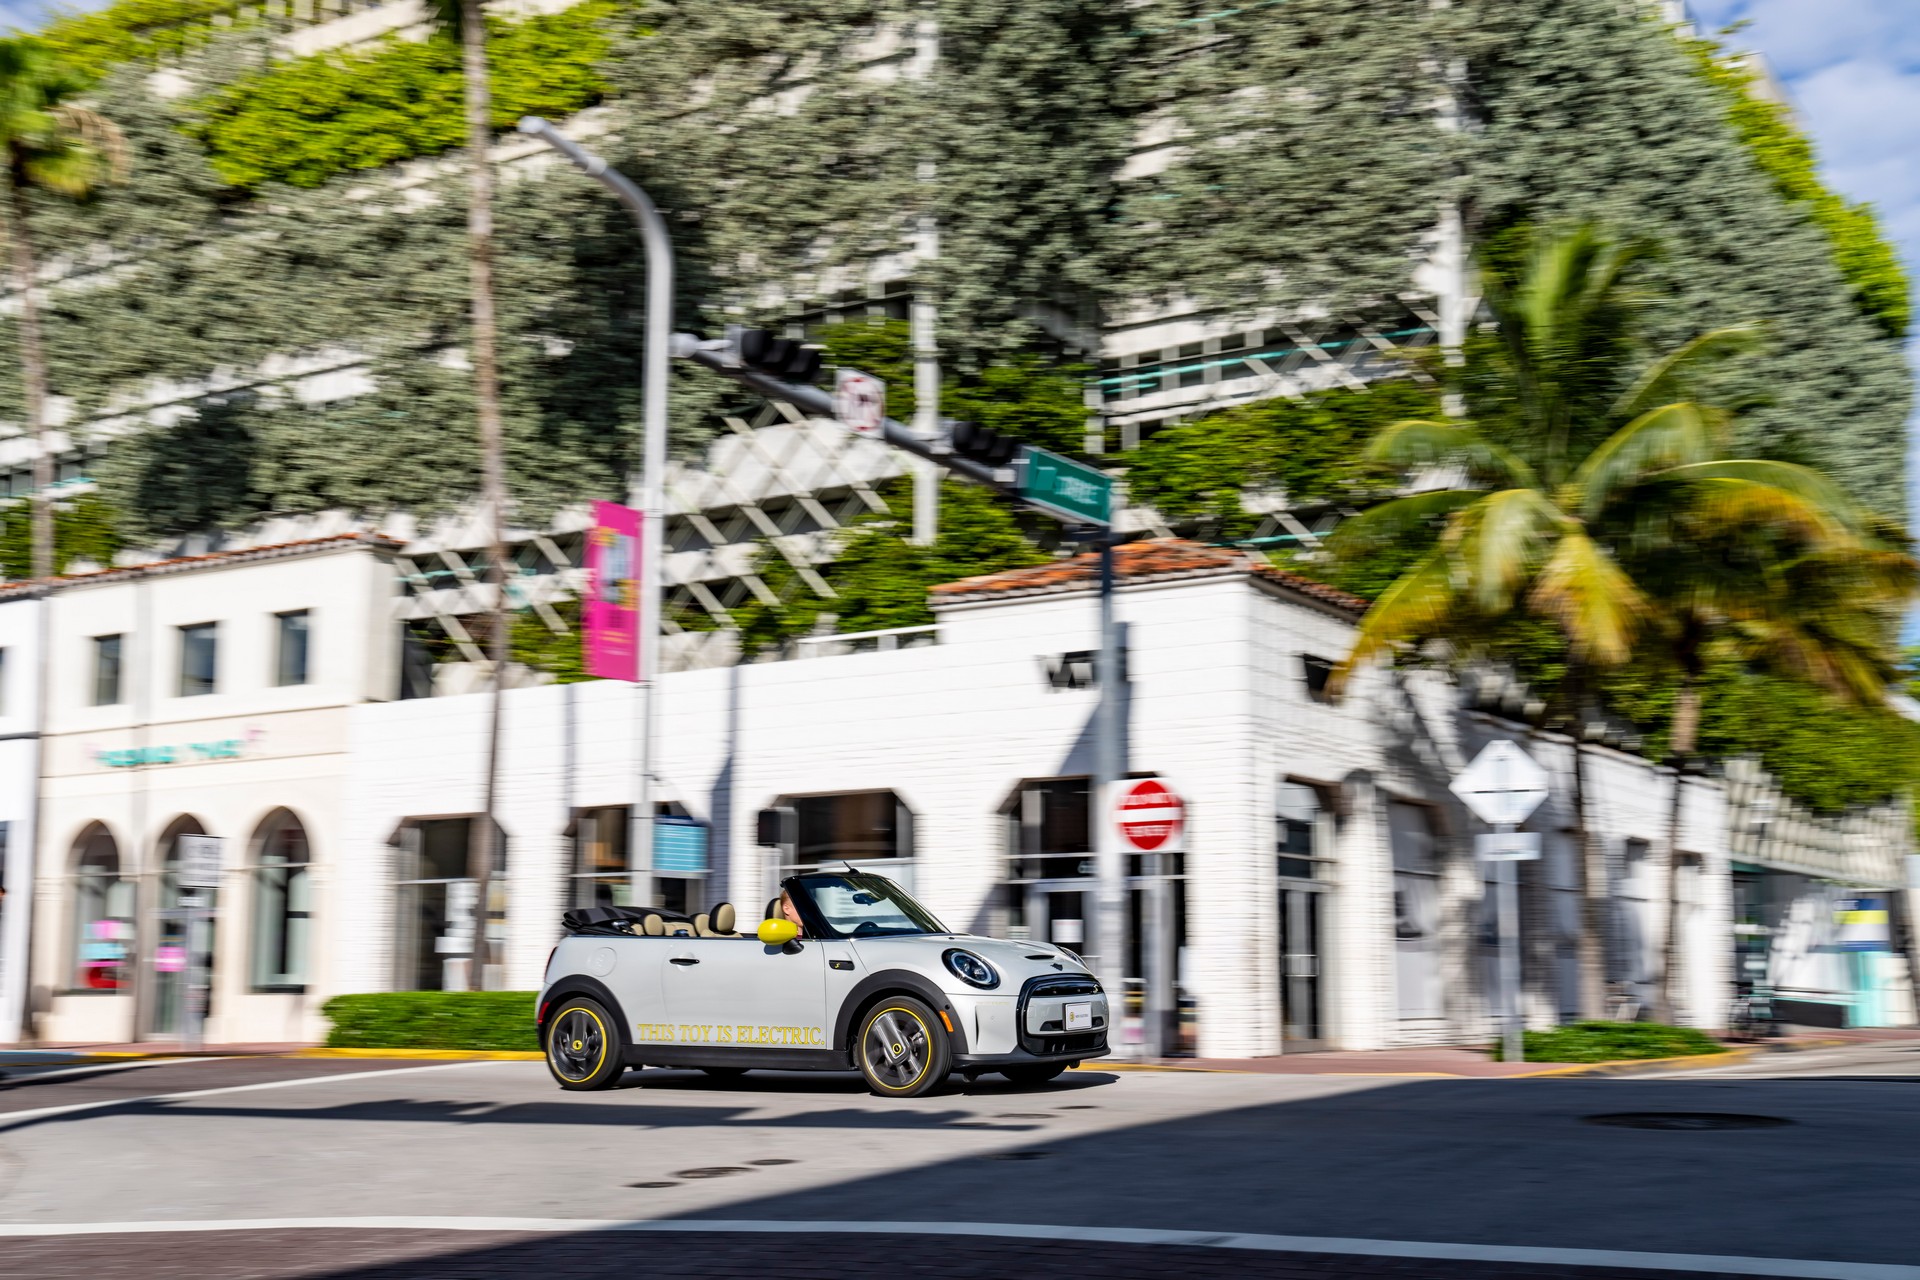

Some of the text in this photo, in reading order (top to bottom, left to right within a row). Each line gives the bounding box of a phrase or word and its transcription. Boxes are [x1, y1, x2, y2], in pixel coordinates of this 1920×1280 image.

[637, 1024, 825, 1045] THIS TOY IS ELECTRIC.
